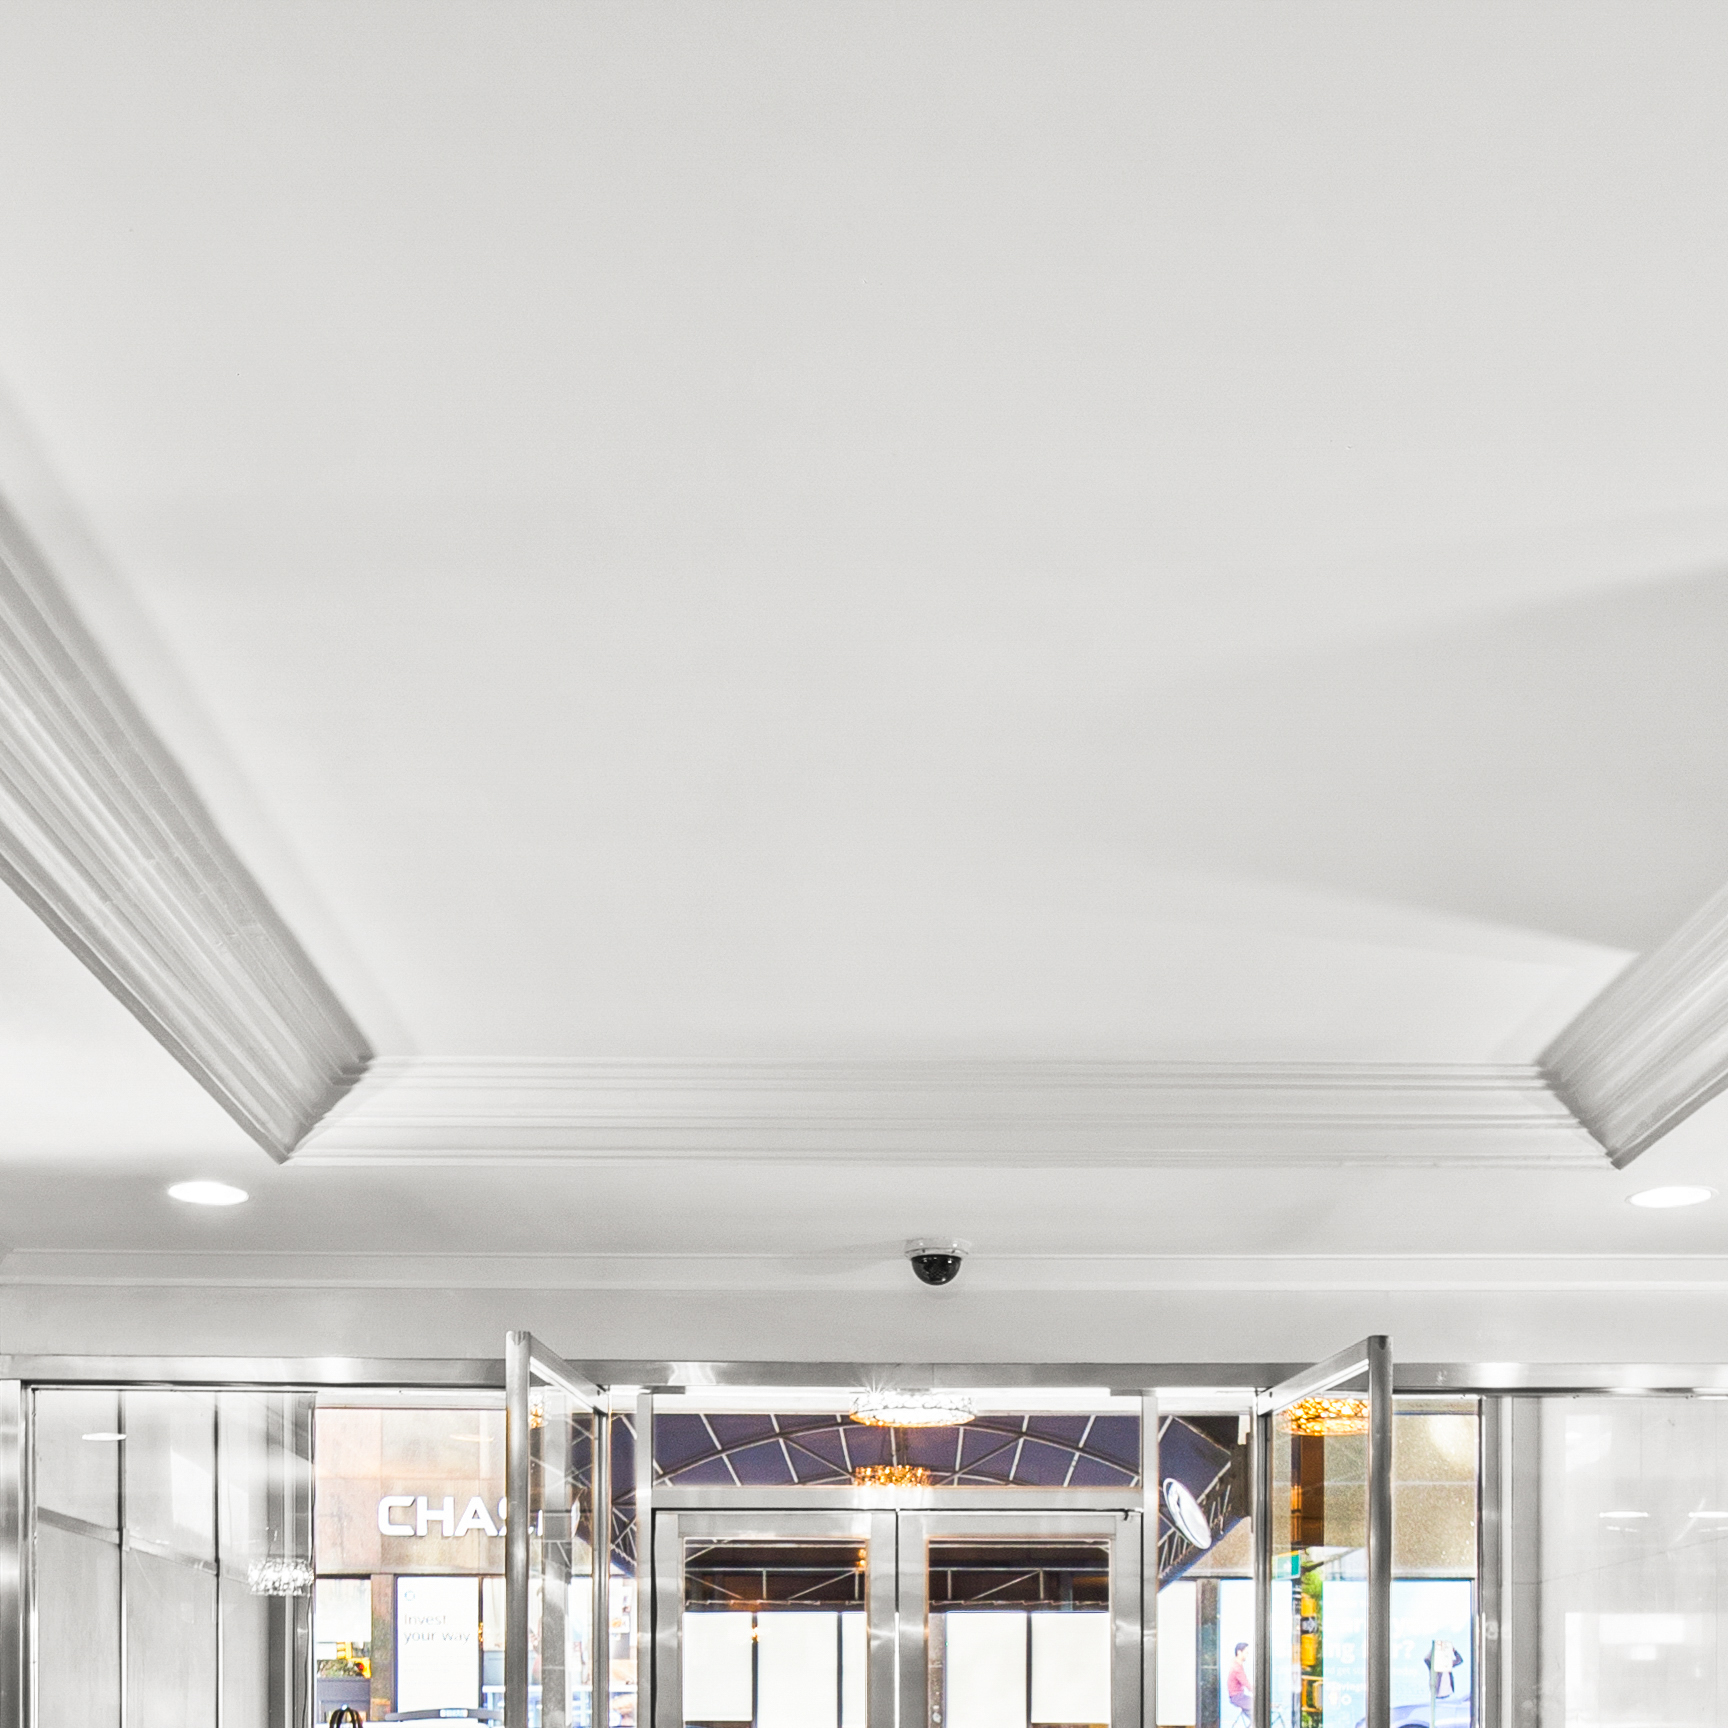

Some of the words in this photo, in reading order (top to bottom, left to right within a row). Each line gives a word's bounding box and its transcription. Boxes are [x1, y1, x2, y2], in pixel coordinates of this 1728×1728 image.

[404, 1614, 446, 1626] Invest
[403, 1632, 437, 1645] your
[441, 1632, 471, 1645] way
